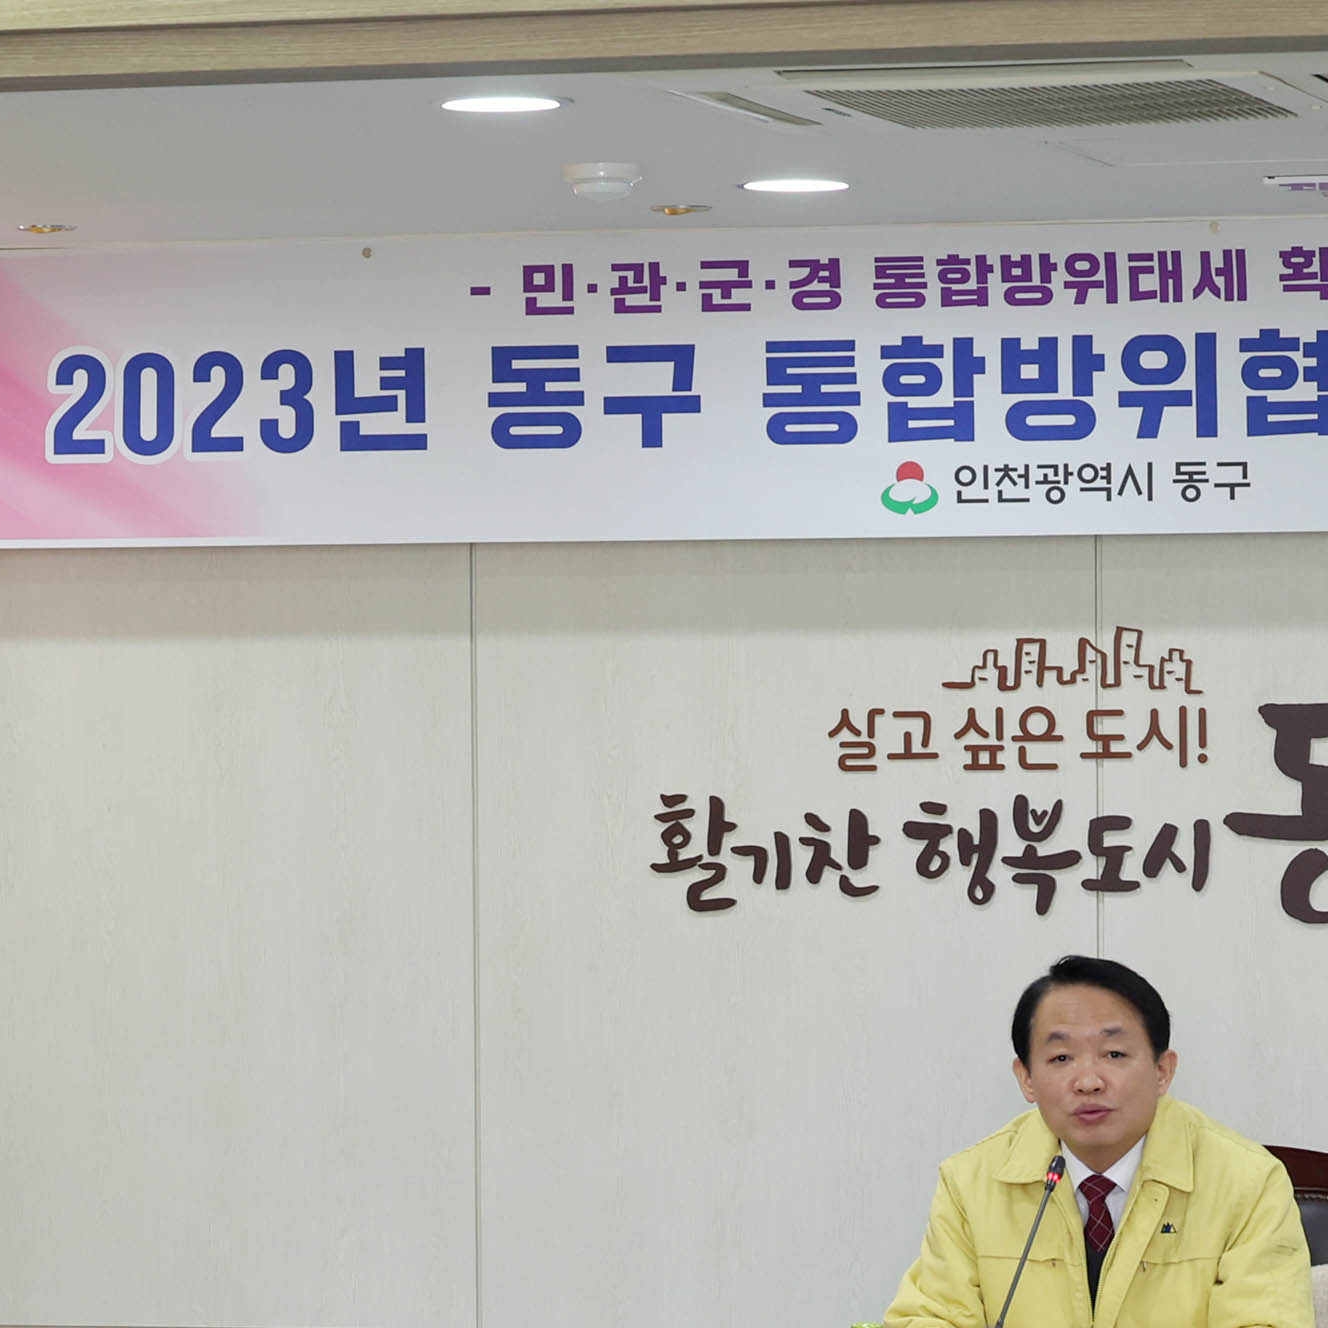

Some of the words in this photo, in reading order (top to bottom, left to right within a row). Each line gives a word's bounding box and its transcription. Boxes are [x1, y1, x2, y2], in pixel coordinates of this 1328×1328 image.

[872, 249, 1248, 309] 통합방위태세
[53, 347, 428, 457] 2023년
[487, 343, 702, 450] 동구
[954, 461, 1154, 505] 인천광역시
[1172, 461, 1251, 503] 동구
[827, 708, 940, 773] 살고
[953, 705, 1064, 772] 싶은
[1079, 705, 1208, 769] 도시!
[649, 793, 881, 913] 활기찬
[902, 794, 1212, 917] 행복도시
